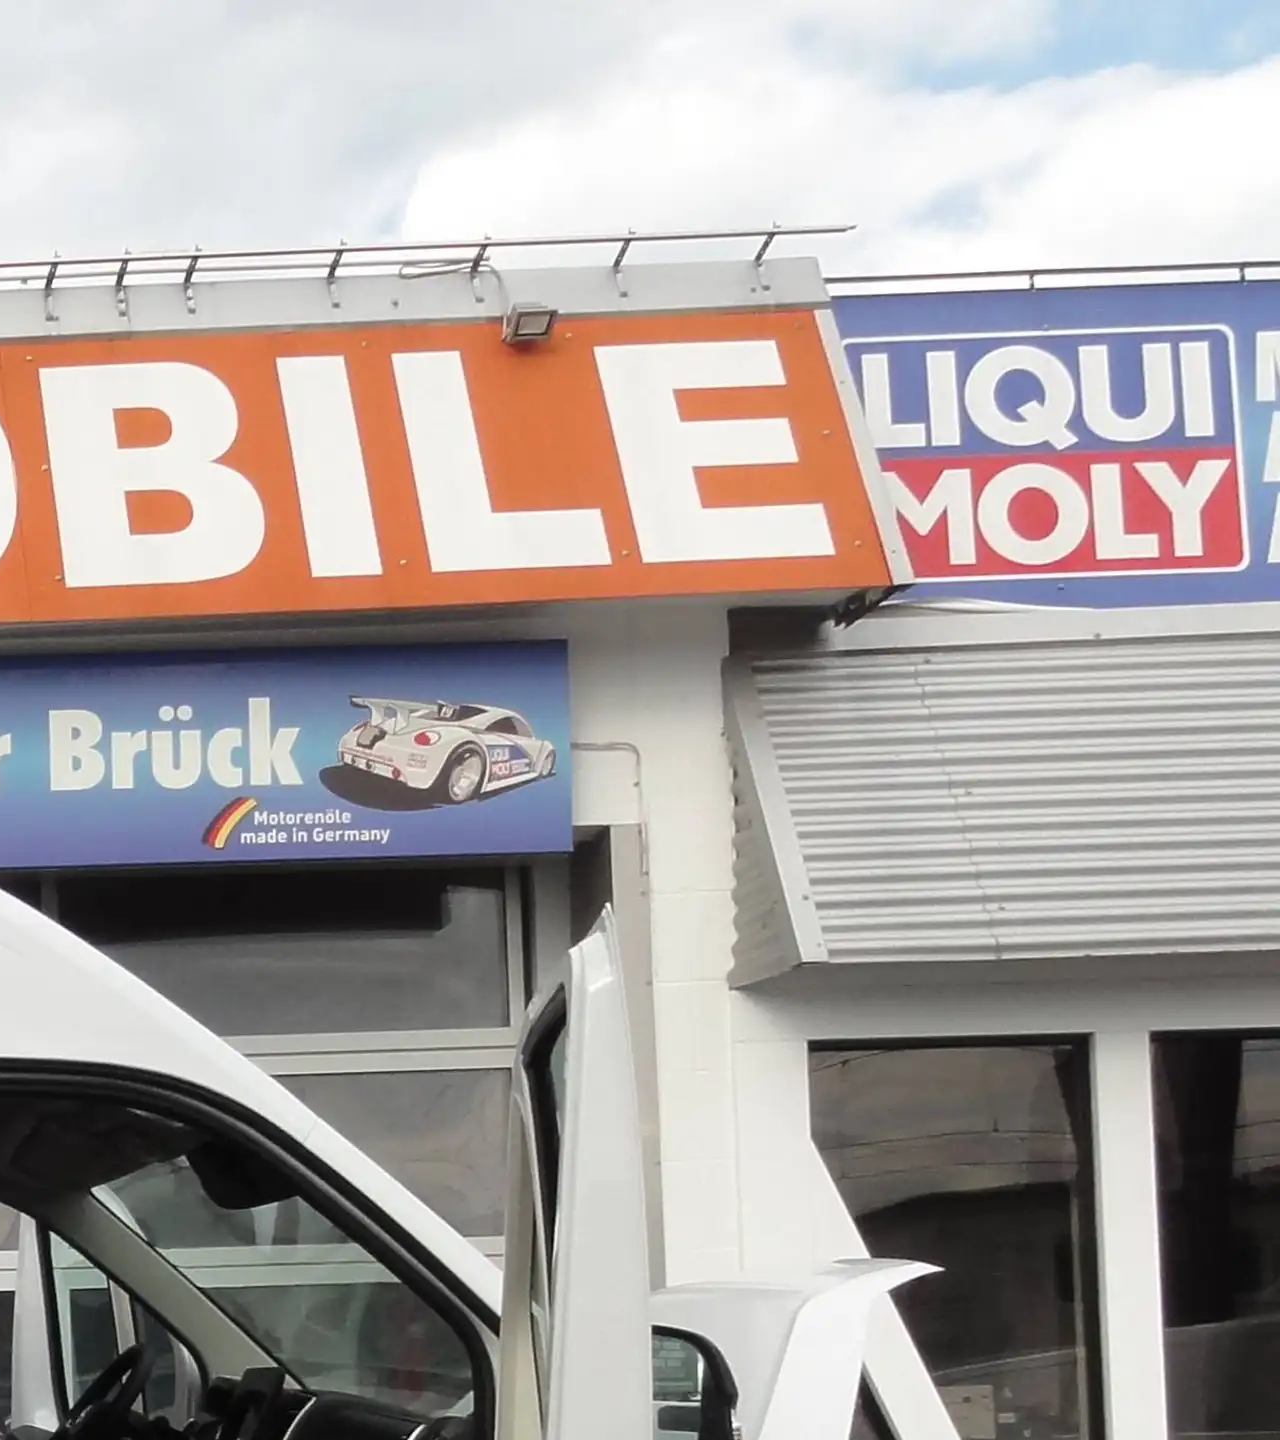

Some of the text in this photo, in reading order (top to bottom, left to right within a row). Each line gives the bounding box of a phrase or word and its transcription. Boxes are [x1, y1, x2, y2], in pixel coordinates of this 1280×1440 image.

[860, 340, 1216, 452] LIQUI
[881, 458, 1232, 566] MOLY
[46, 696, 305, 794] Brück
[240, 827, 391, 844] made in Germany
[253, 808, 352, 825] Motorenöle
